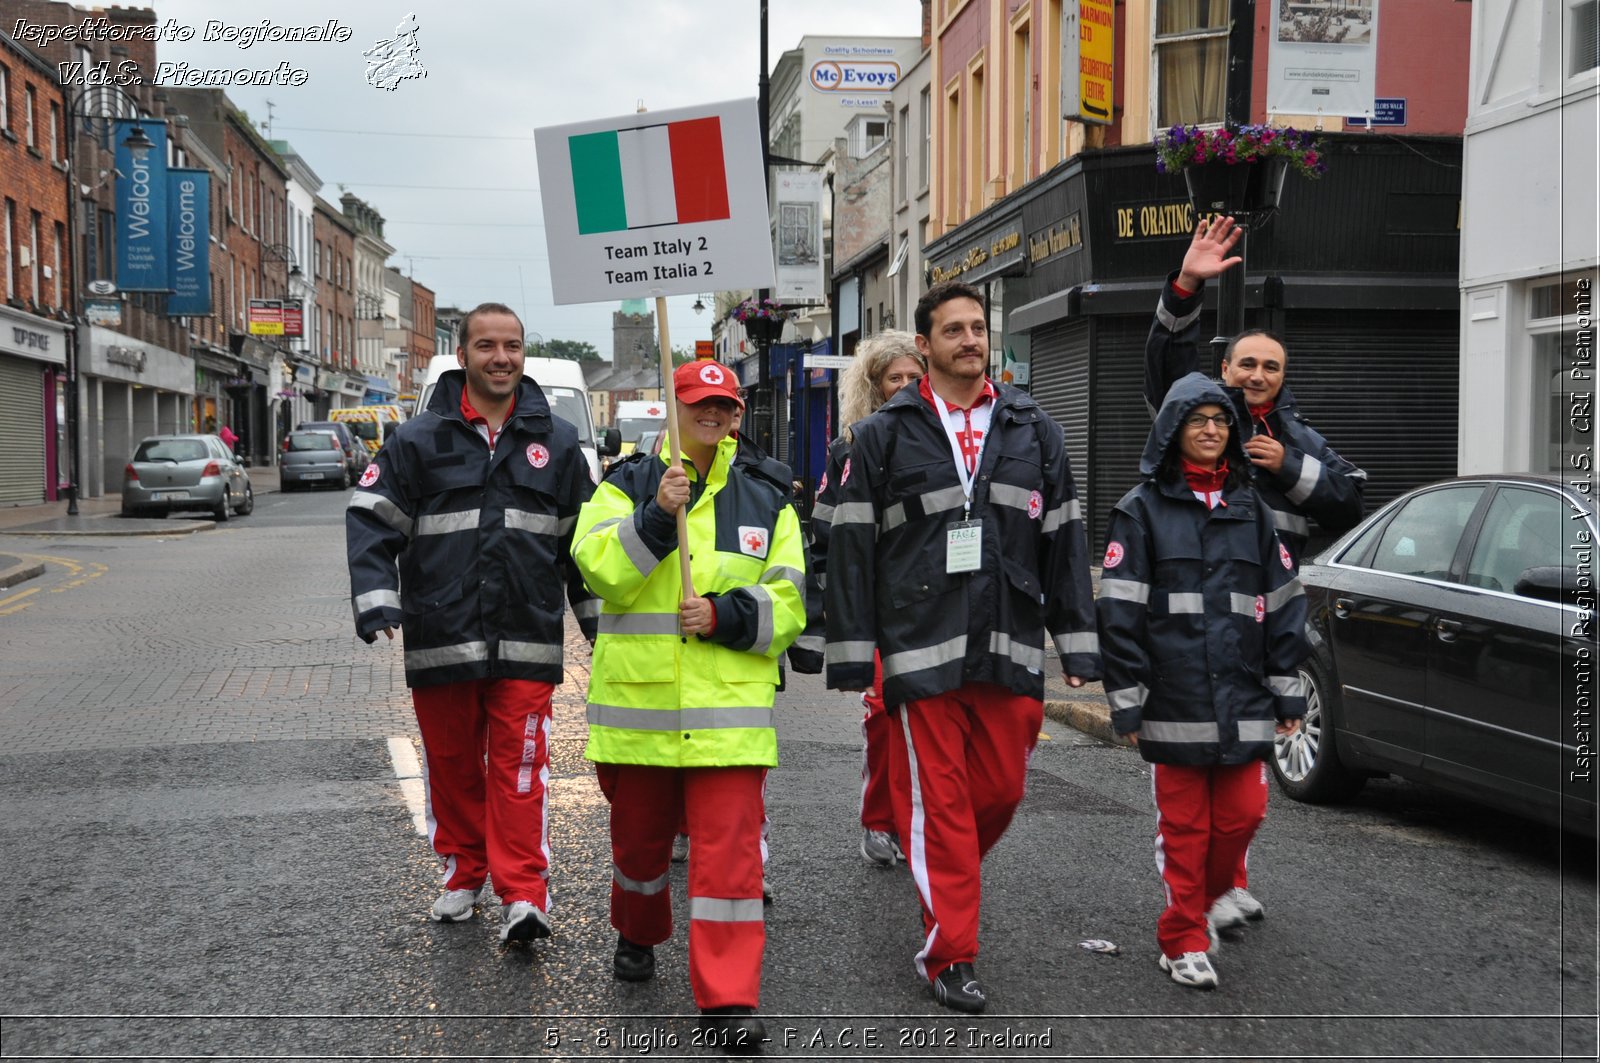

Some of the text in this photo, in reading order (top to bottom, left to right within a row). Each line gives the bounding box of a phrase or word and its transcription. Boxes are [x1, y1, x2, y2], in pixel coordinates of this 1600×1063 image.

[1080, 4, 1112, 28] MARMION
[1080, 24, 1092, 42] LTD
[1085, 80, 1105, 101] CENTRE
[176, 180, 195, 271] Welcome
[604, 236, 708, 260] Team Italy 2
[605, 261, 714, 284] Team Italia 2
